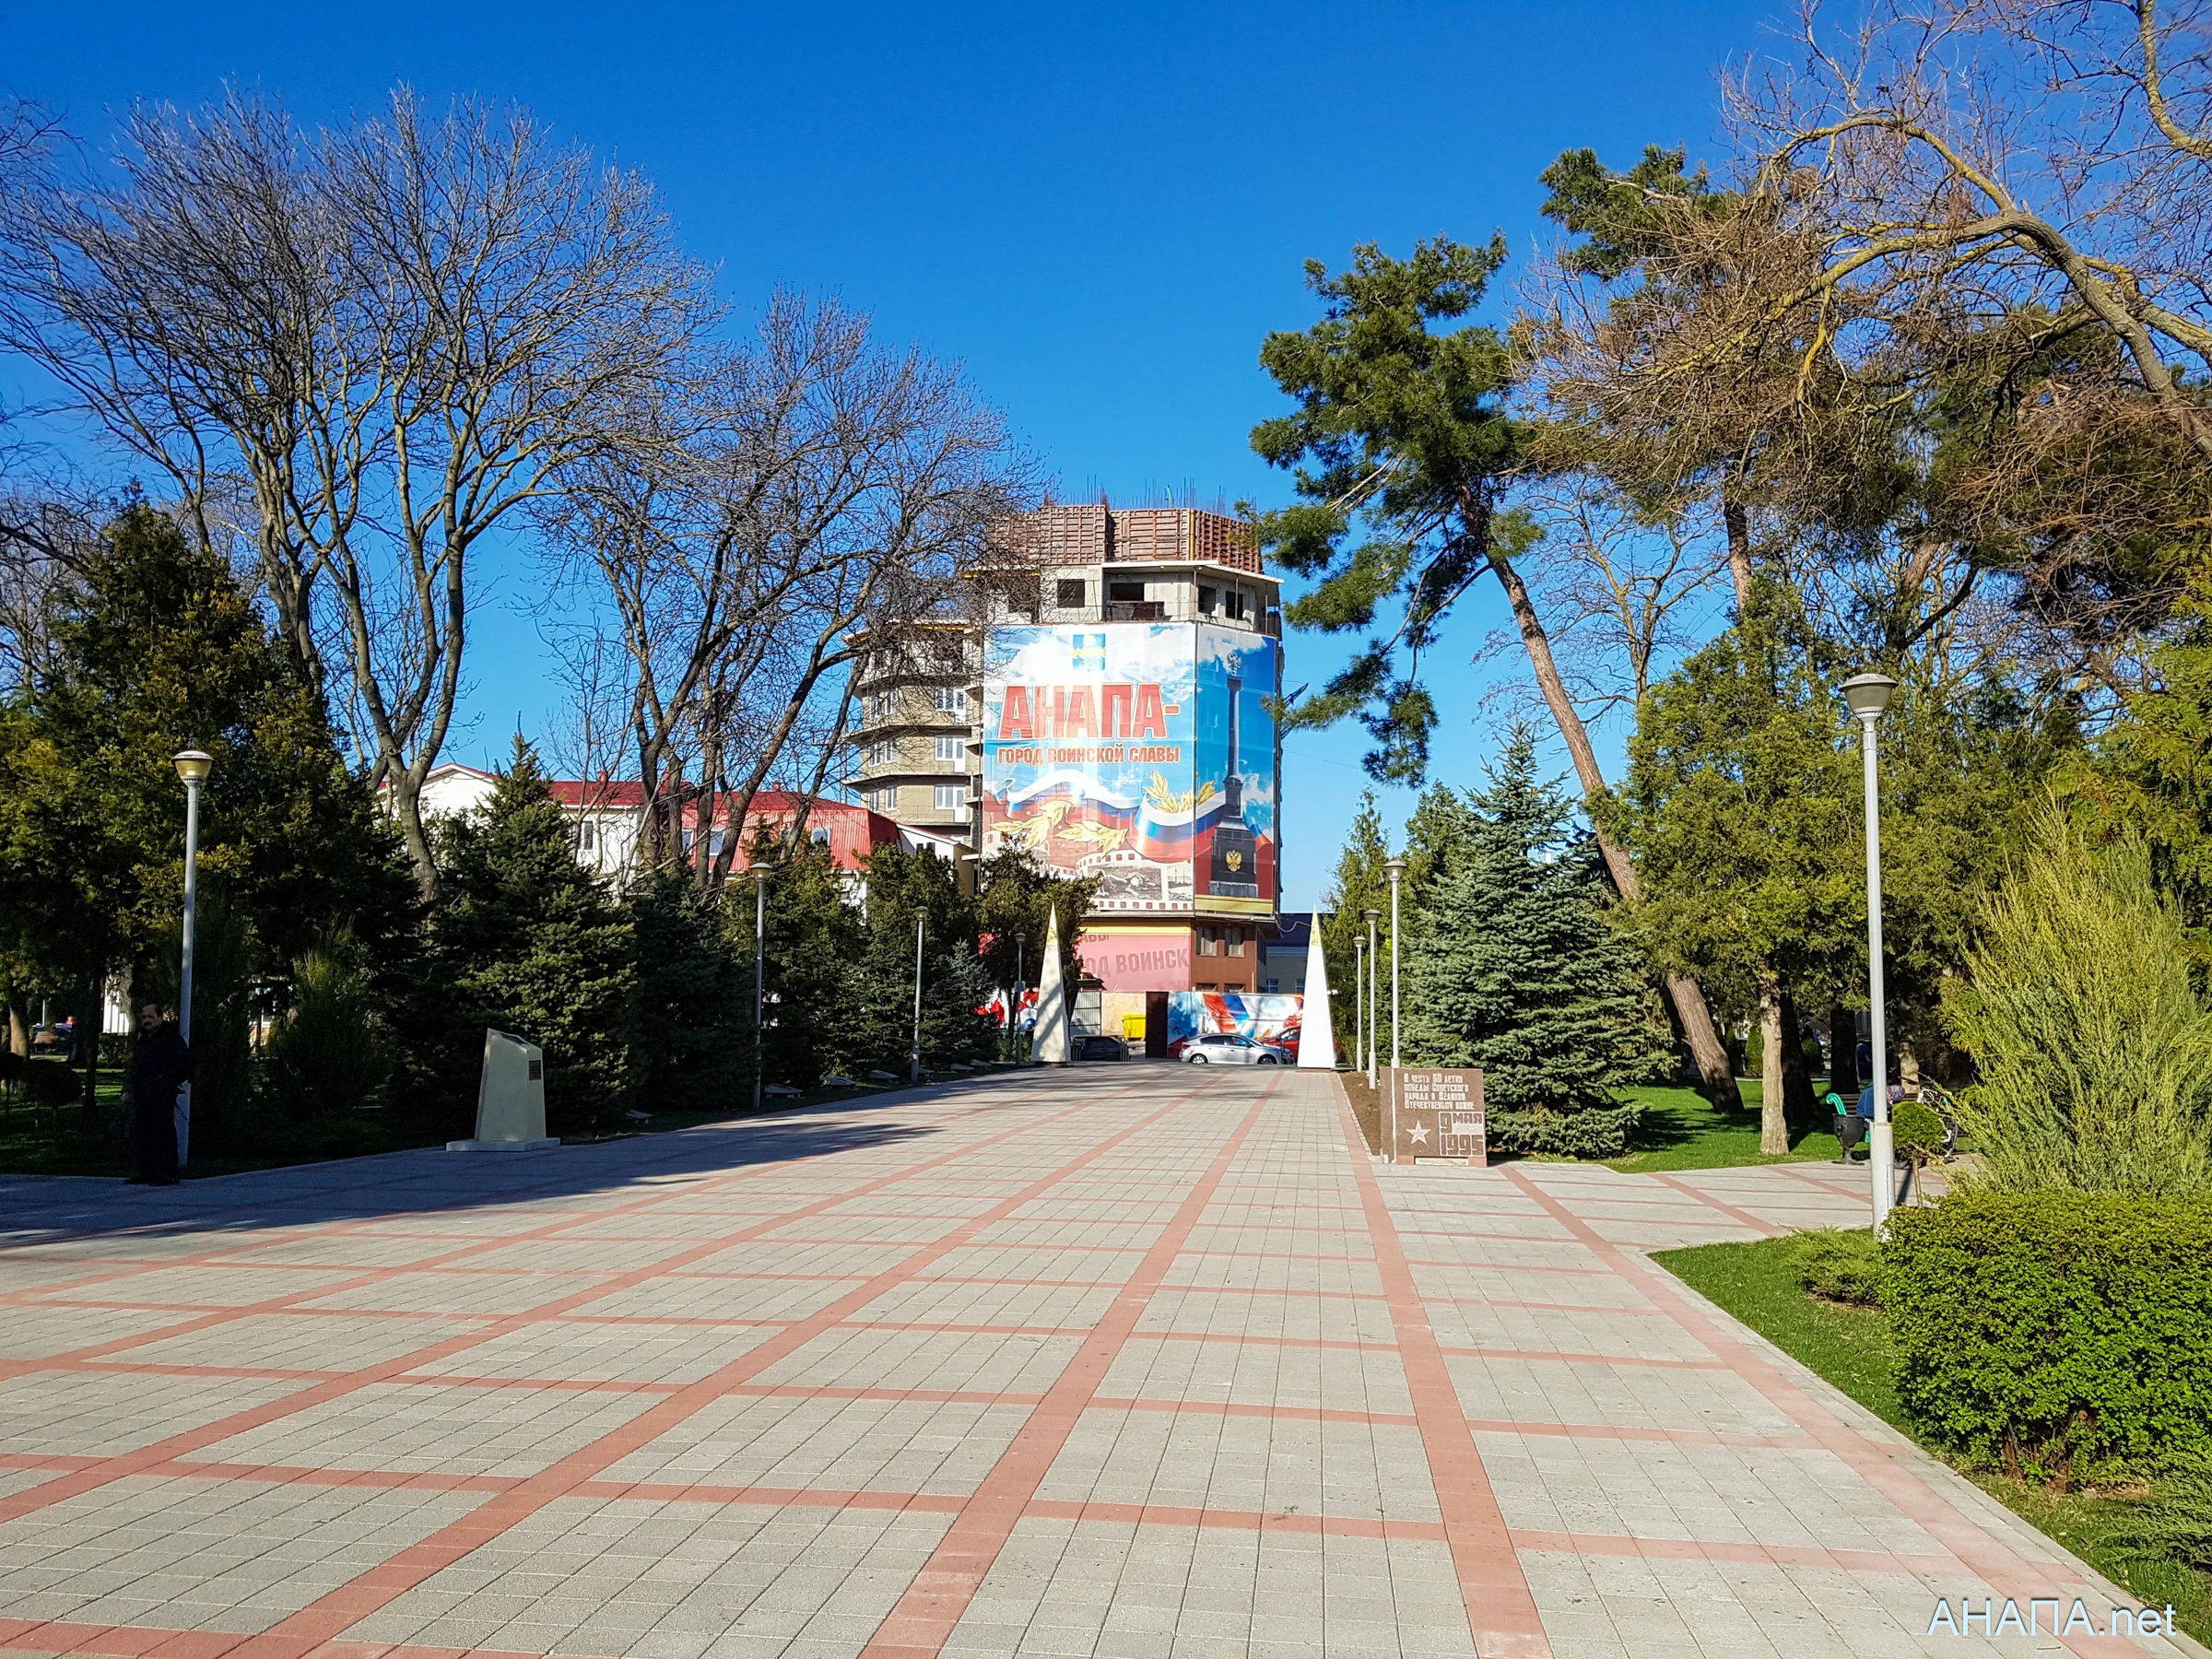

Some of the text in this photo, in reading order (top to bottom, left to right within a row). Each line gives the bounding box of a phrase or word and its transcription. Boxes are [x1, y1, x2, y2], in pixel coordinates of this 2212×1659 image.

[998, 683, 1181, 739] АНАПА-
[997, 743, 1180, 766] ГОРОД ВОИНСКОЙ СЛАВЫ
[1440, 1112, 1483, 1134] 9 МАЯ
[1441, 1134, 1484, 1156] 1995
